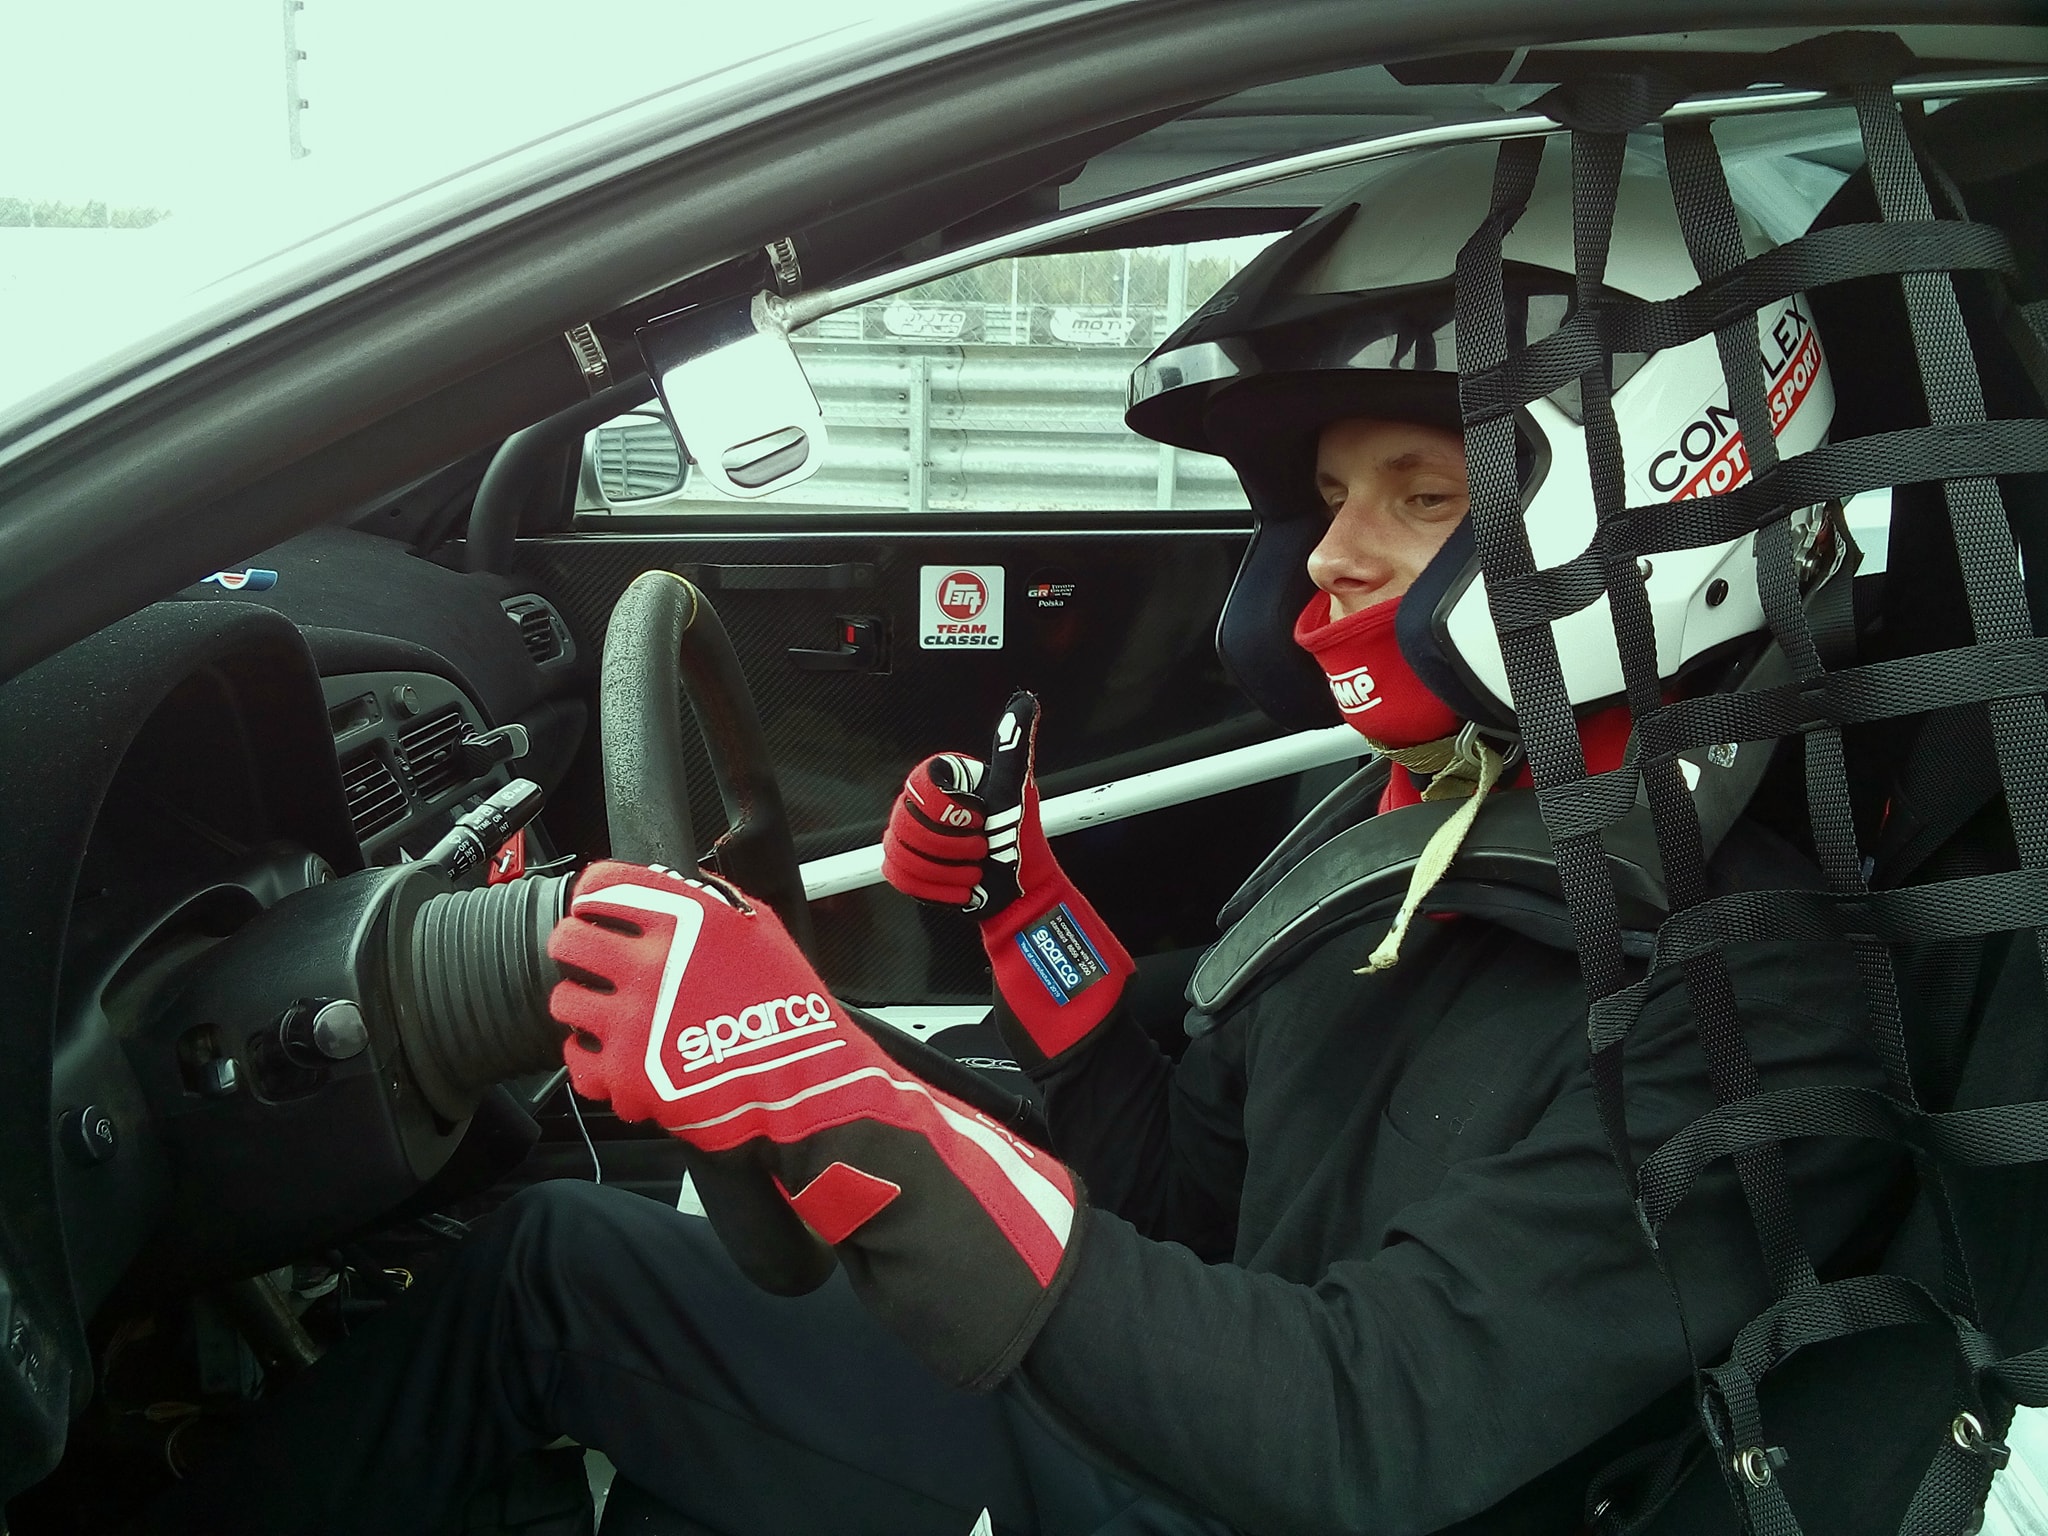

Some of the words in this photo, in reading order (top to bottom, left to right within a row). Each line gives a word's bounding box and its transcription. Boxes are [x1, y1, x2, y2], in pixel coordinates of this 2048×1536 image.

[937, 624, 987, 634] TEAM
[924, 635, 999, 646] CLASSIC
[458, 840, 470, 852] OFF
[1034, 929, 1079, 987] sparco
[1087, 960, 1097, 972] FIA
[677, 992, 831, 1064] sparco
